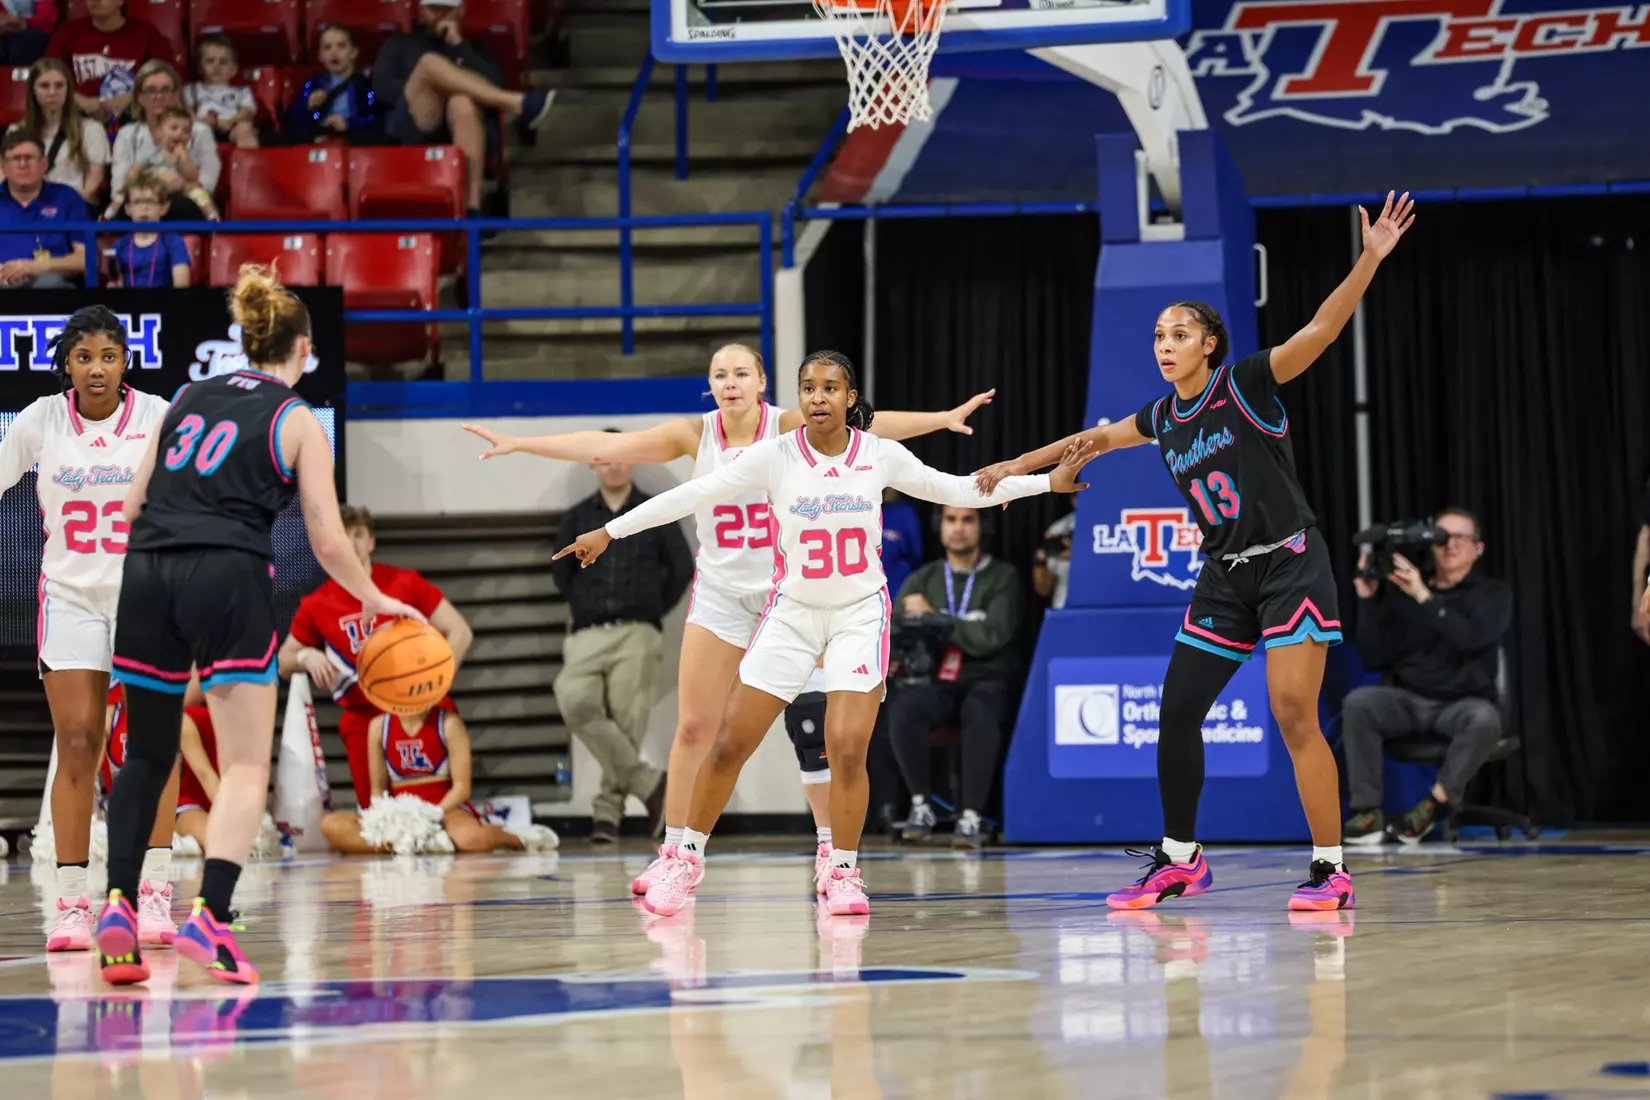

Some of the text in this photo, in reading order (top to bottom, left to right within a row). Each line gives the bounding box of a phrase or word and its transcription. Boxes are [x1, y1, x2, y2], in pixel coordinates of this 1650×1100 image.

[0, 314, 162, 371] TEH
[164, 412, 239, 477] 30
[1165, 426, 1236, 485] Panthers
[52, 464, 137, 493] Lady Techste
[1189, 470, 1241, 526] 13
[61, 500, 130, 555] 23
[712, 503, 773, 549] 25
[789, 493, 873, 521] Lady Techsters
[799, 527, 869, 579] 30
[1093, 524, 1136, 554] LA
[1122, 684, 1158, 700] North
[1230, 699, 1248, 721] &
[1123, 722, 1264, 749] Spo edicine
